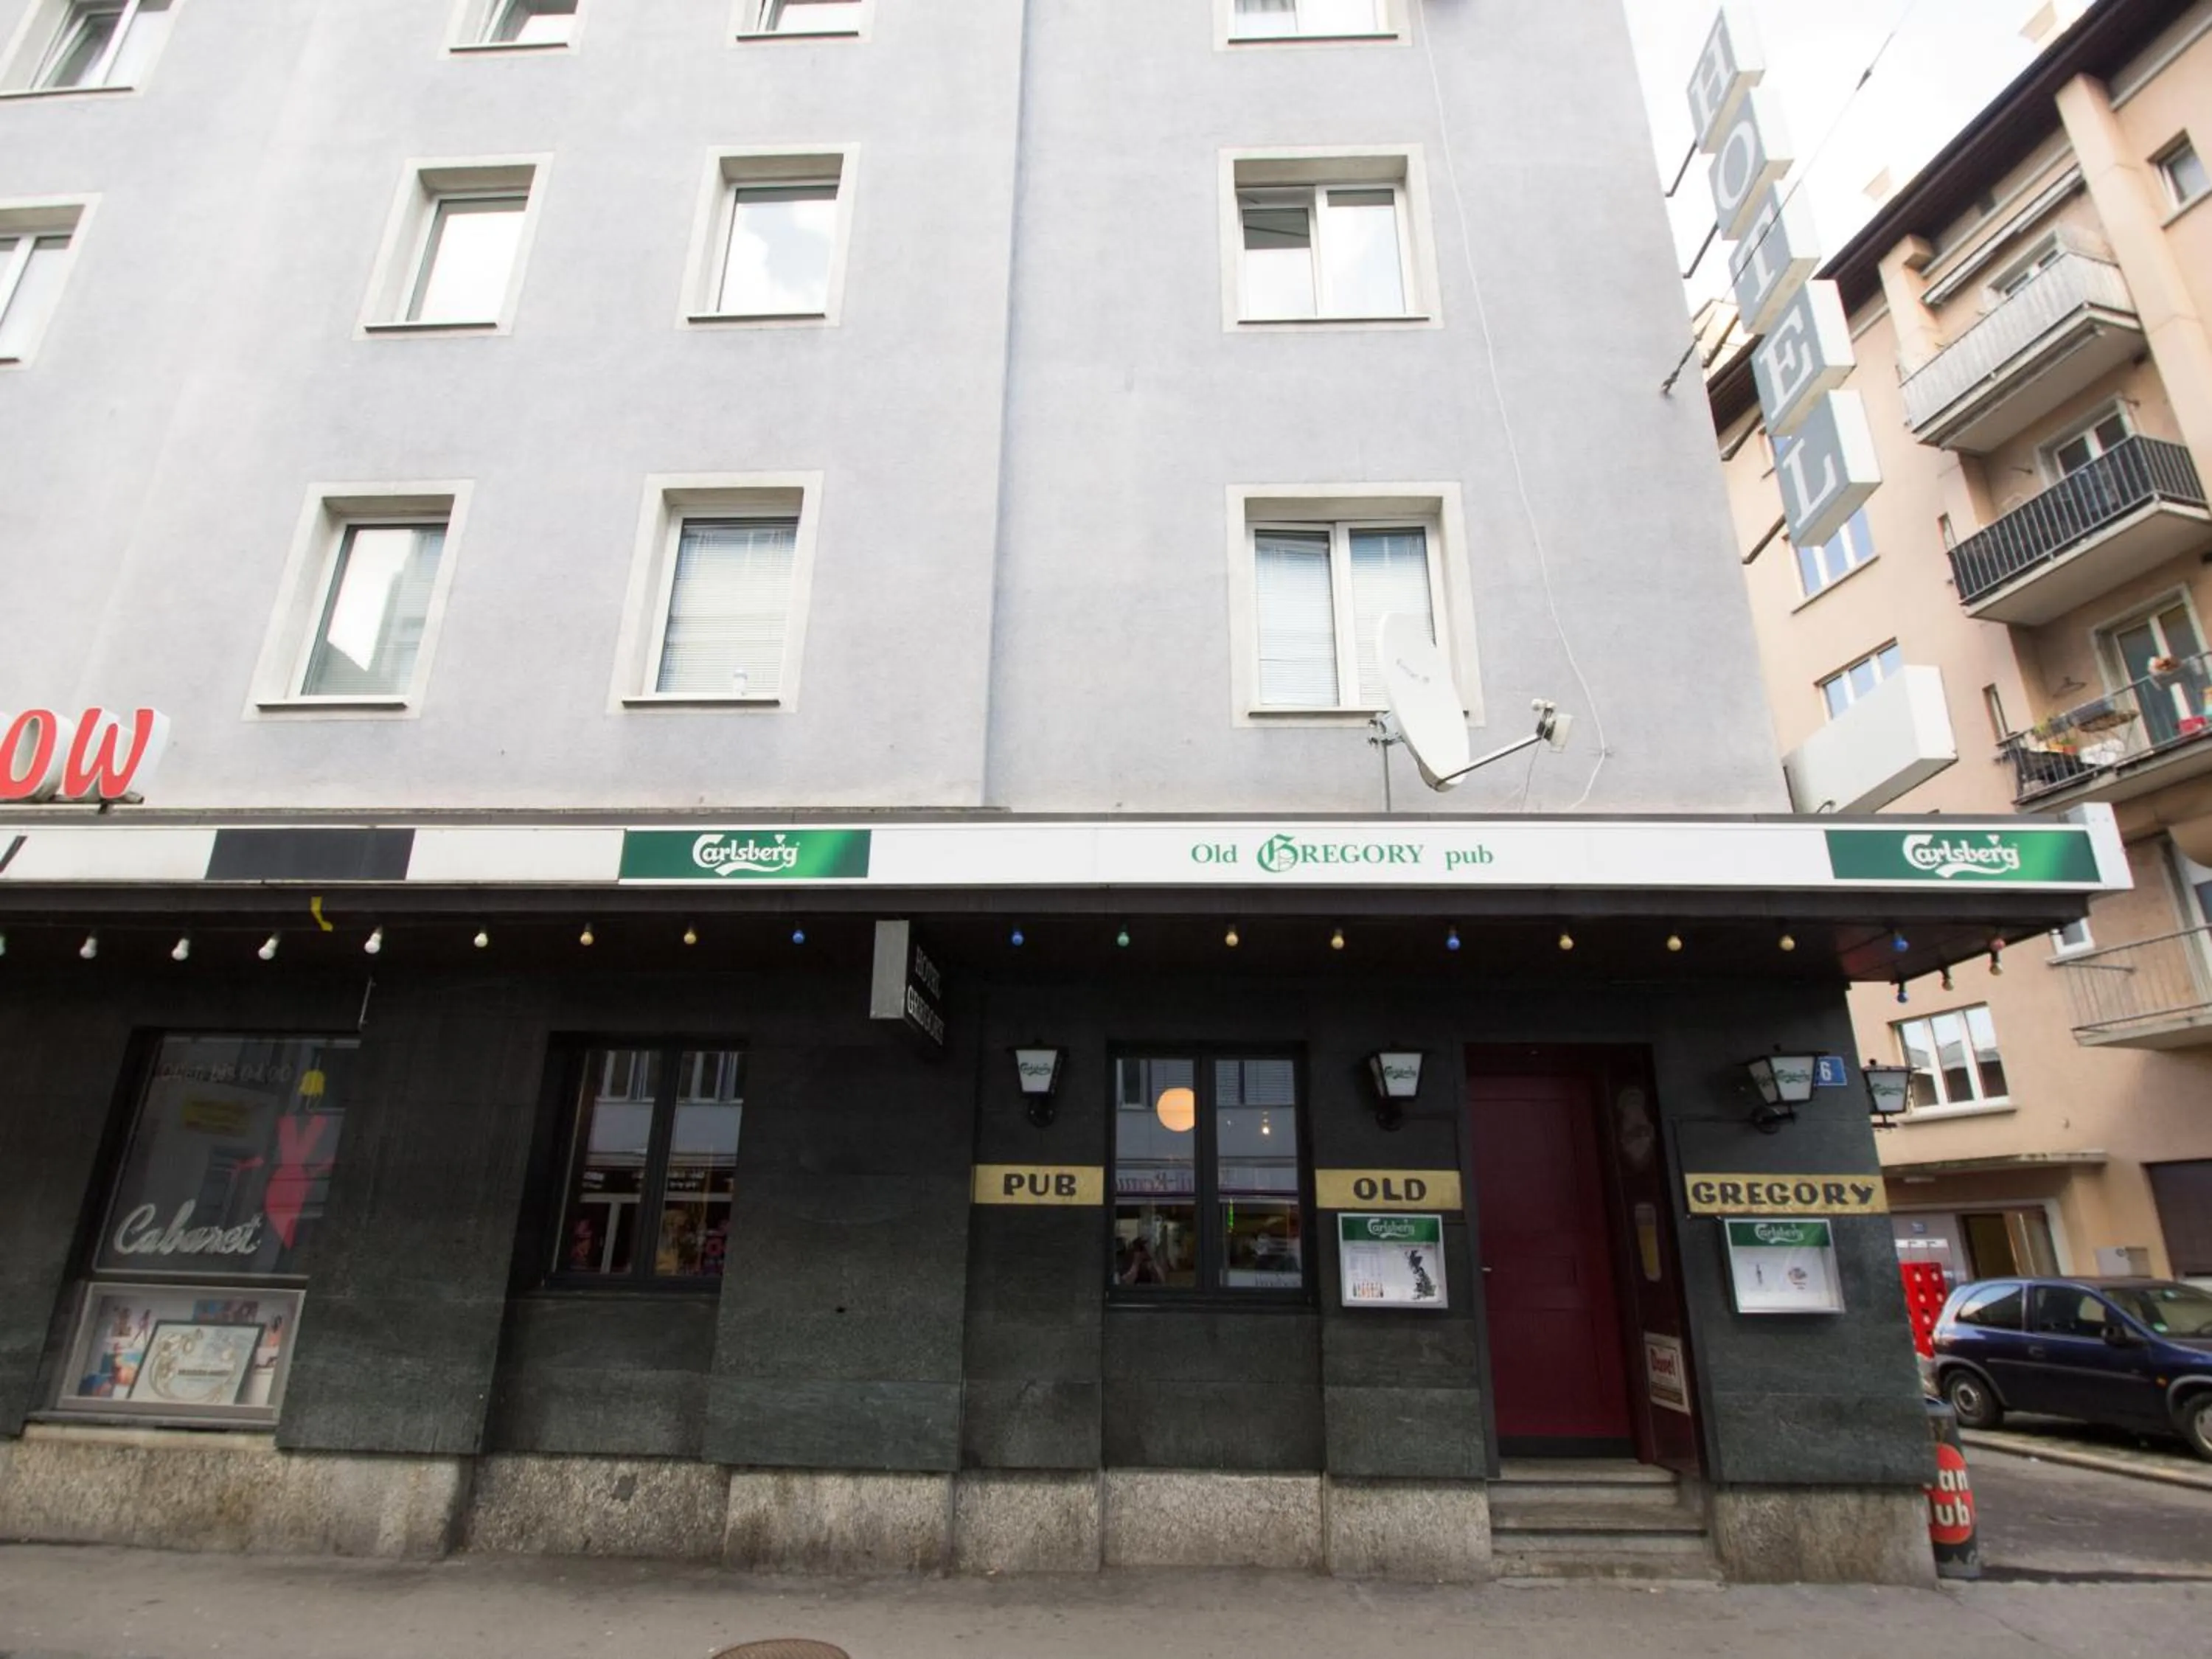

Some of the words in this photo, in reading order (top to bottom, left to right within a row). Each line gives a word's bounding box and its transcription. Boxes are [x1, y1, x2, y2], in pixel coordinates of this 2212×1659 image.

[1691, 21, 1837, 529] HOTEL
[692, 833, 798, 876] Carlsberg
[1191, 844, 1237, 864] Old
[1256, 833, 1425, 873] GREGORY
[1444, 844, 1494, 871] pub
[1902, 833, 2020, 877] Carlsberg
[1819, 1060, 1832, 1082] 6
[1003, 1173, 1077, 1197] PUB
[1353, 1178, 1427, 1201] OLD
[1691, 1181, 1874, 1206] GREGORY
[113, 1198, 263, 1256] Cabaret
[1367, 1217, 1416, 1239] Carlsberg
[1753, 1222, 1805, 1245] Carlsberg
